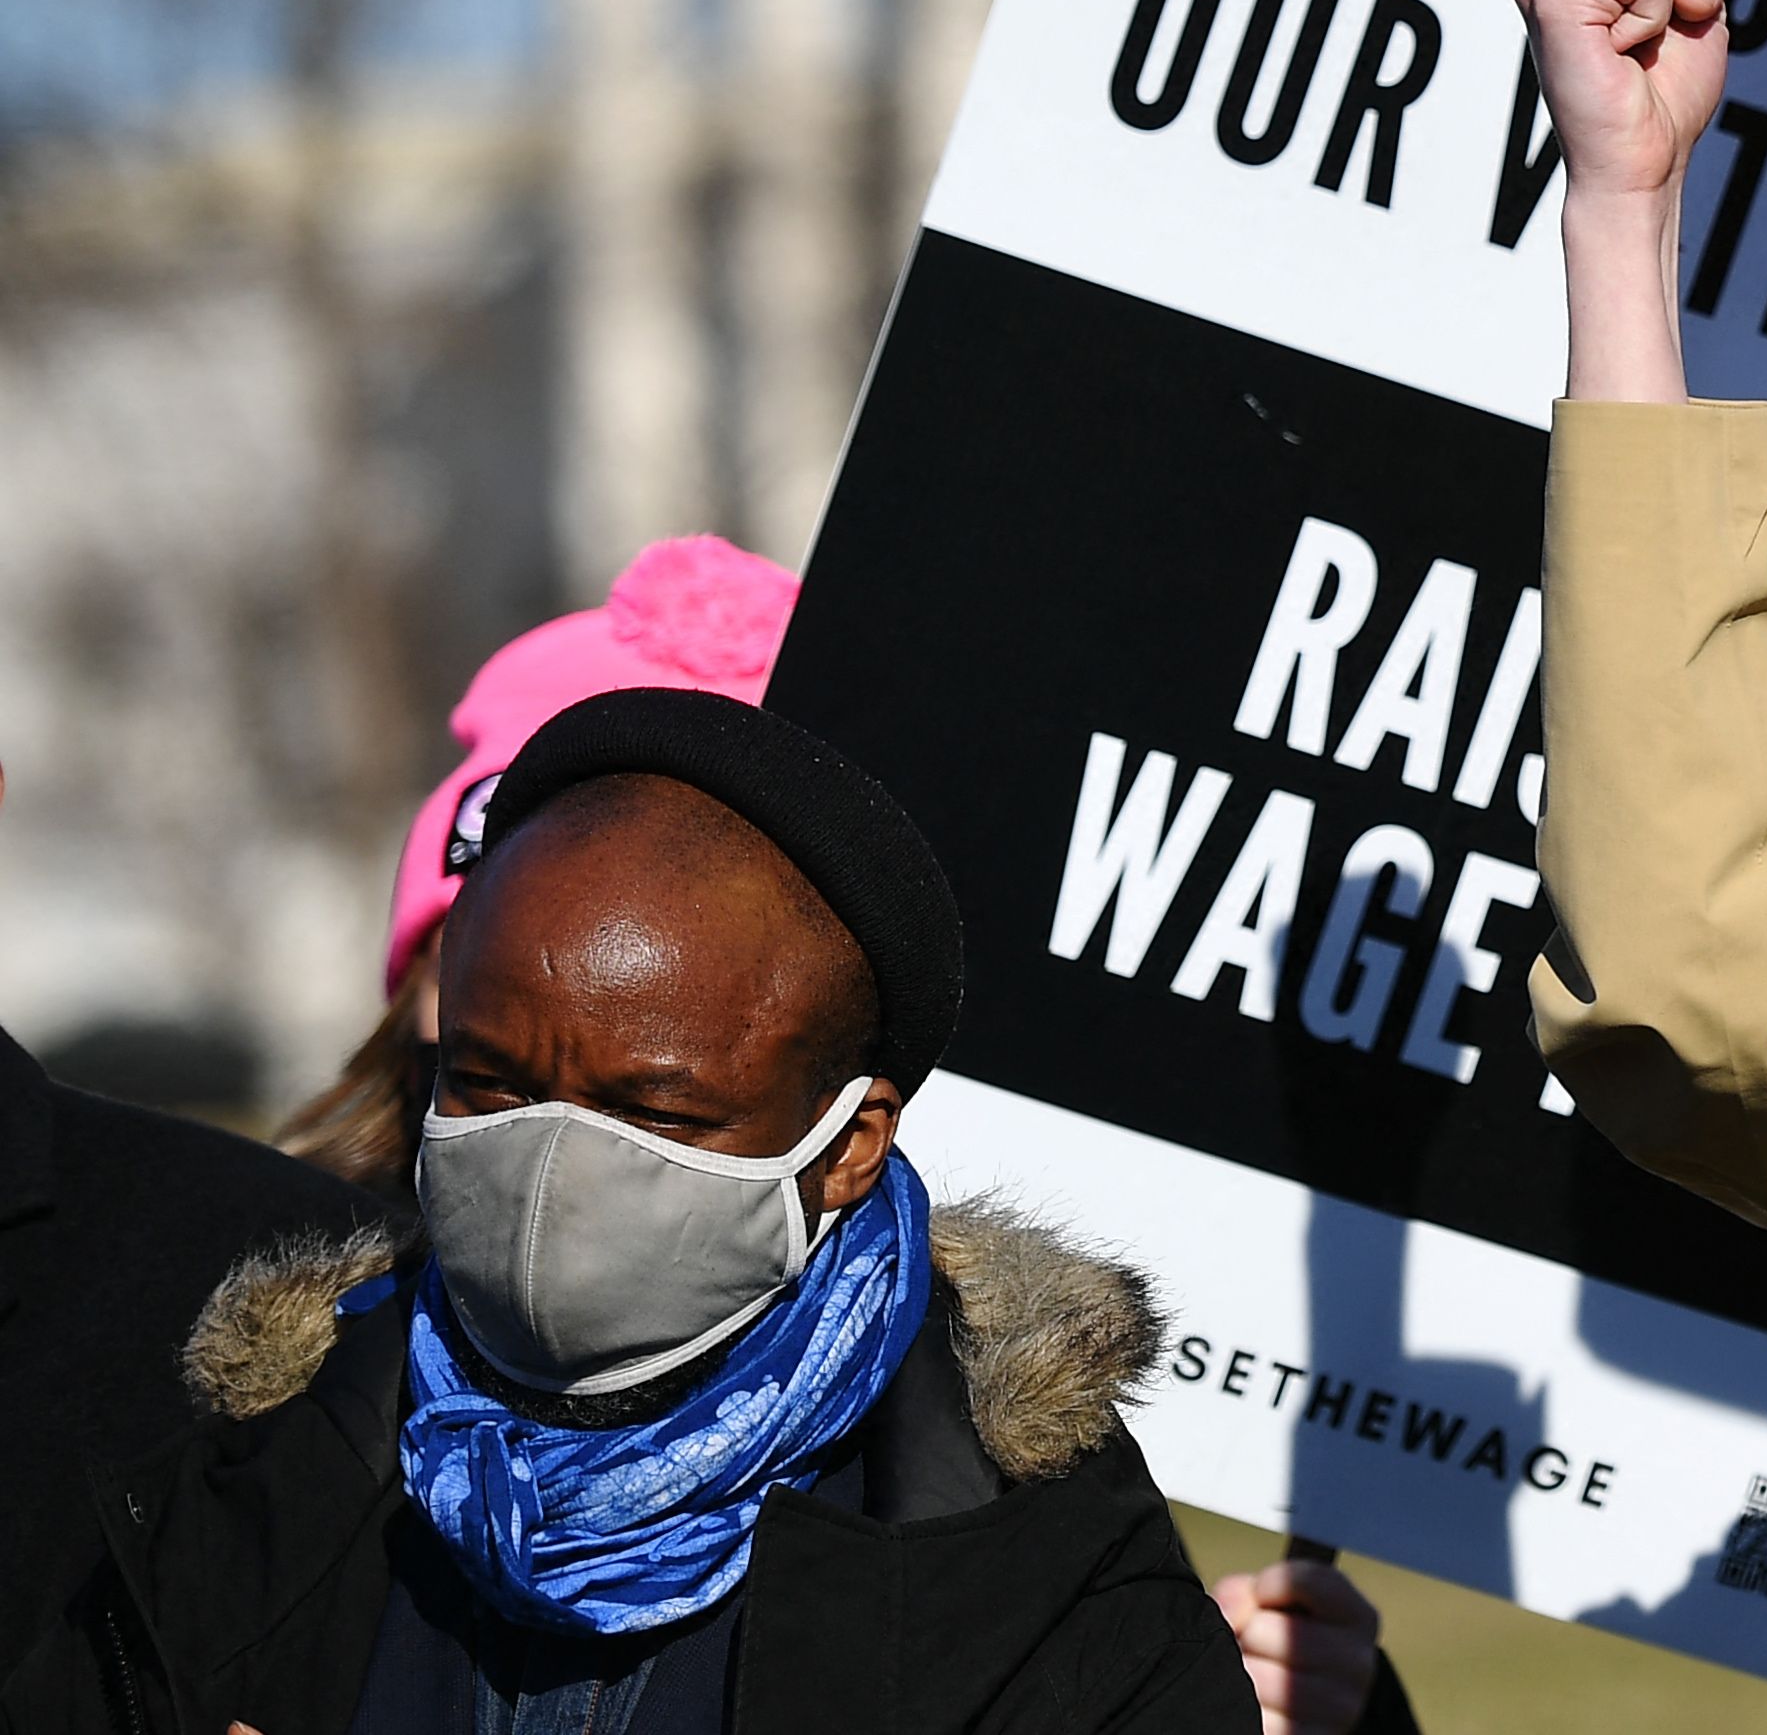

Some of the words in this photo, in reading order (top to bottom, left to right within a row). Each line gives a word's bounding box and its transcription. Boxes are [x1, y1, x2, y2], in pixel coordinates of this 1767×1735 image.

[1233, 516, 1545, 827] RAI
[1047, 731, 1540, 1085] WAGE
[1171, 1335, 1620, 1512] SETHEWAGE
